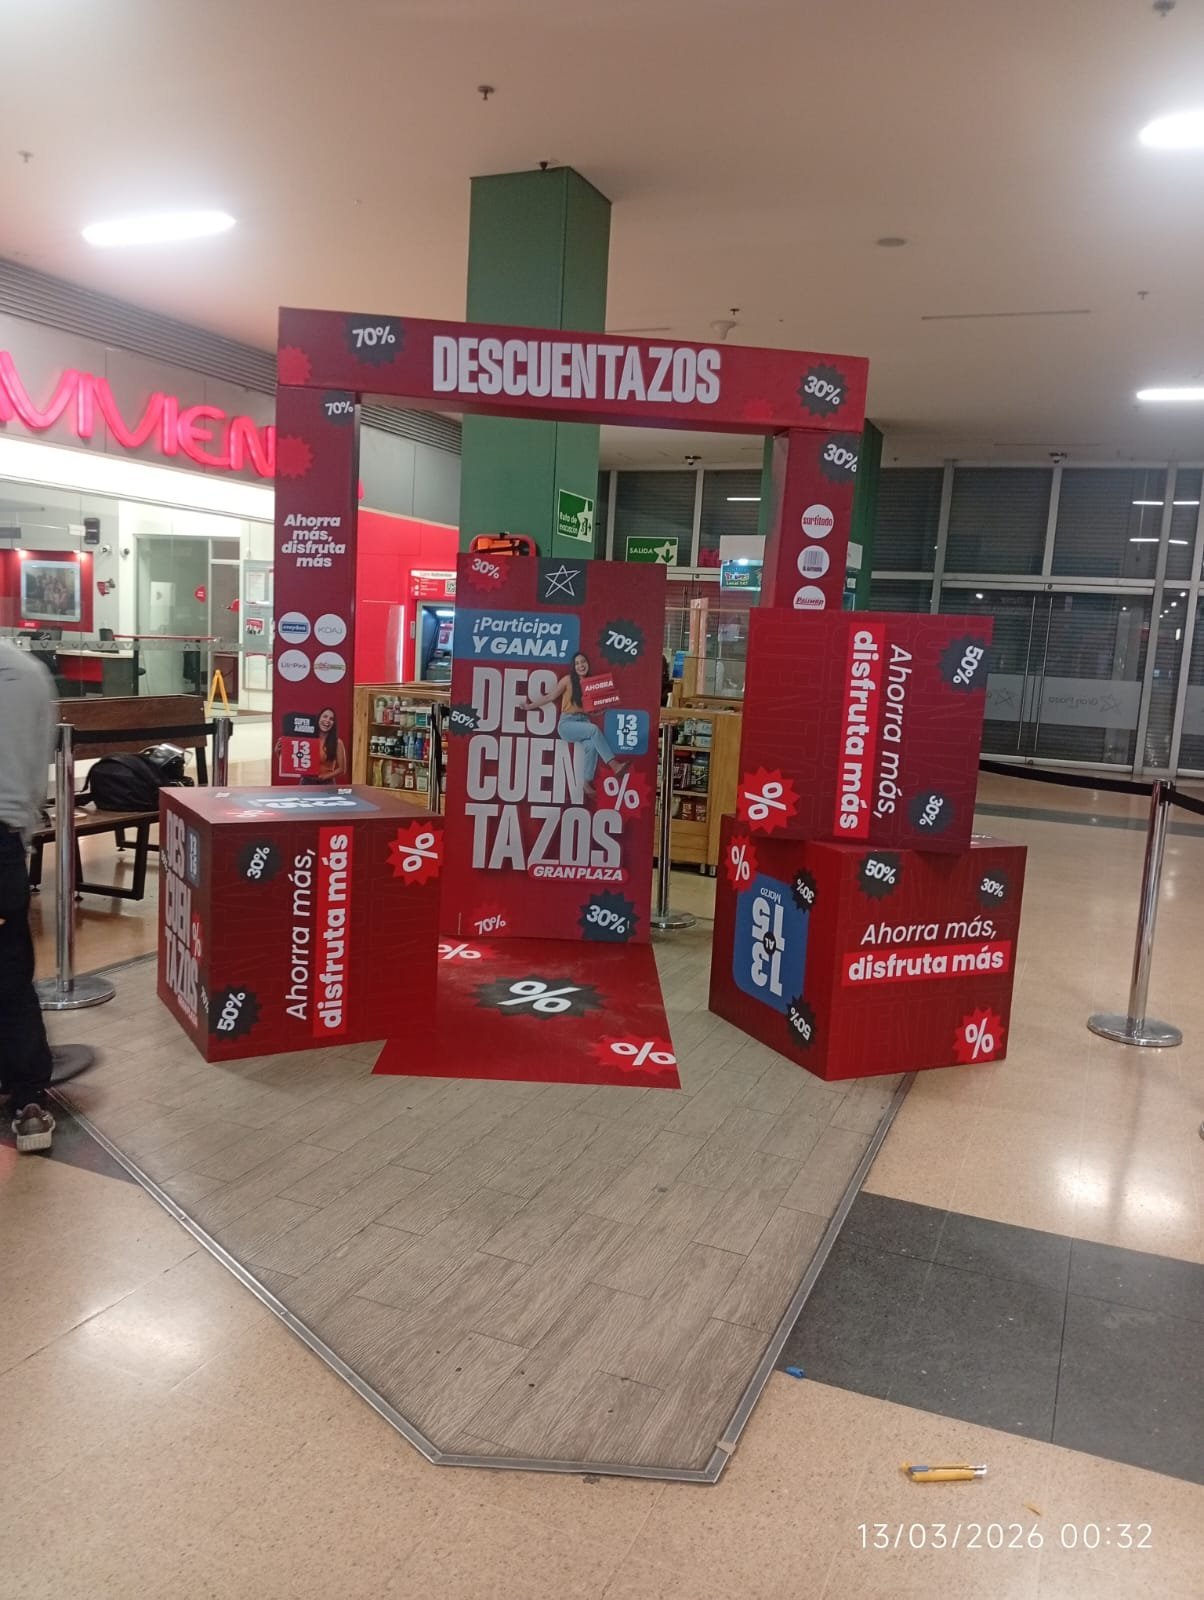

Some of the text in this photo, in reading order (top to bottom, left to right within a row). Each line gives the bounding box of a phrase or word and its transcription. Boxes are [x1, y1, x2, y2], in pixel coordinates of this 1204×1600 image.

[352, 326, 396, 348] 70%
[433, 335, 721, 404] DESCUENTAZOS
[804, 375, 842, 405] 30%
[0, 350, 276, 478] VIVIEN
[324, 401, 354, 415] 70%
[823, 443, 858, 472] 30%
[284, 514, 341, 527] Ahorra
[280, 540, 346, 554] disfruta
[292, 528, 333, 543] más,
[296, 555, 332, 568] más
[472, 558, 500, 579] 30%
[473, 617, 563, 638] ¡Participa
[472, 635, 569, 657] Y GANA!
[605, 630, 639, 655] 70%
[953, 645, 984, 685] 50%
[471, 666, 558, 736] DES
[450, 711, 475, 728] 50%
[617, 714, 637, 731] 13
[839, 630, 879, 829] disfruta más
[873, 644, 912, 819] Ahorra más,
[291, 740, 310, 755] 13
[616, 730, 638, 747] 15
[292, 754, 311, 768] 15
[466, 734, 585, 805] CUEN
[919, 795, 944, 827] 30%
[465, 803, 622, 870] TAZOS
[246, 847, 270, 879] 30%
[533, 865, 623, 882] GRAN PLAZA
[865, 859, 896, 884] 50%
[760, 887, 782, 904] Marzo
[797, 879, 815, 904] 30%
[980, 878, 1004, 897] 30%
[317, 834, 348, 1029] disfruta más
[474, 914, 506, 935] 70%
[586, 905, 626, 934] 30%
[752, 897, 786, 951] 15
[860, 915, 997, 945] Ahorra más,
[285, 849, 316, 1020] Ahorra más,
[751, 941, 783, 998] 13
[848, 945, 1004, 981] disfruta más
[217, 992, 246, 1031] 50%
[790, 1007, 812, 1041] 50%
